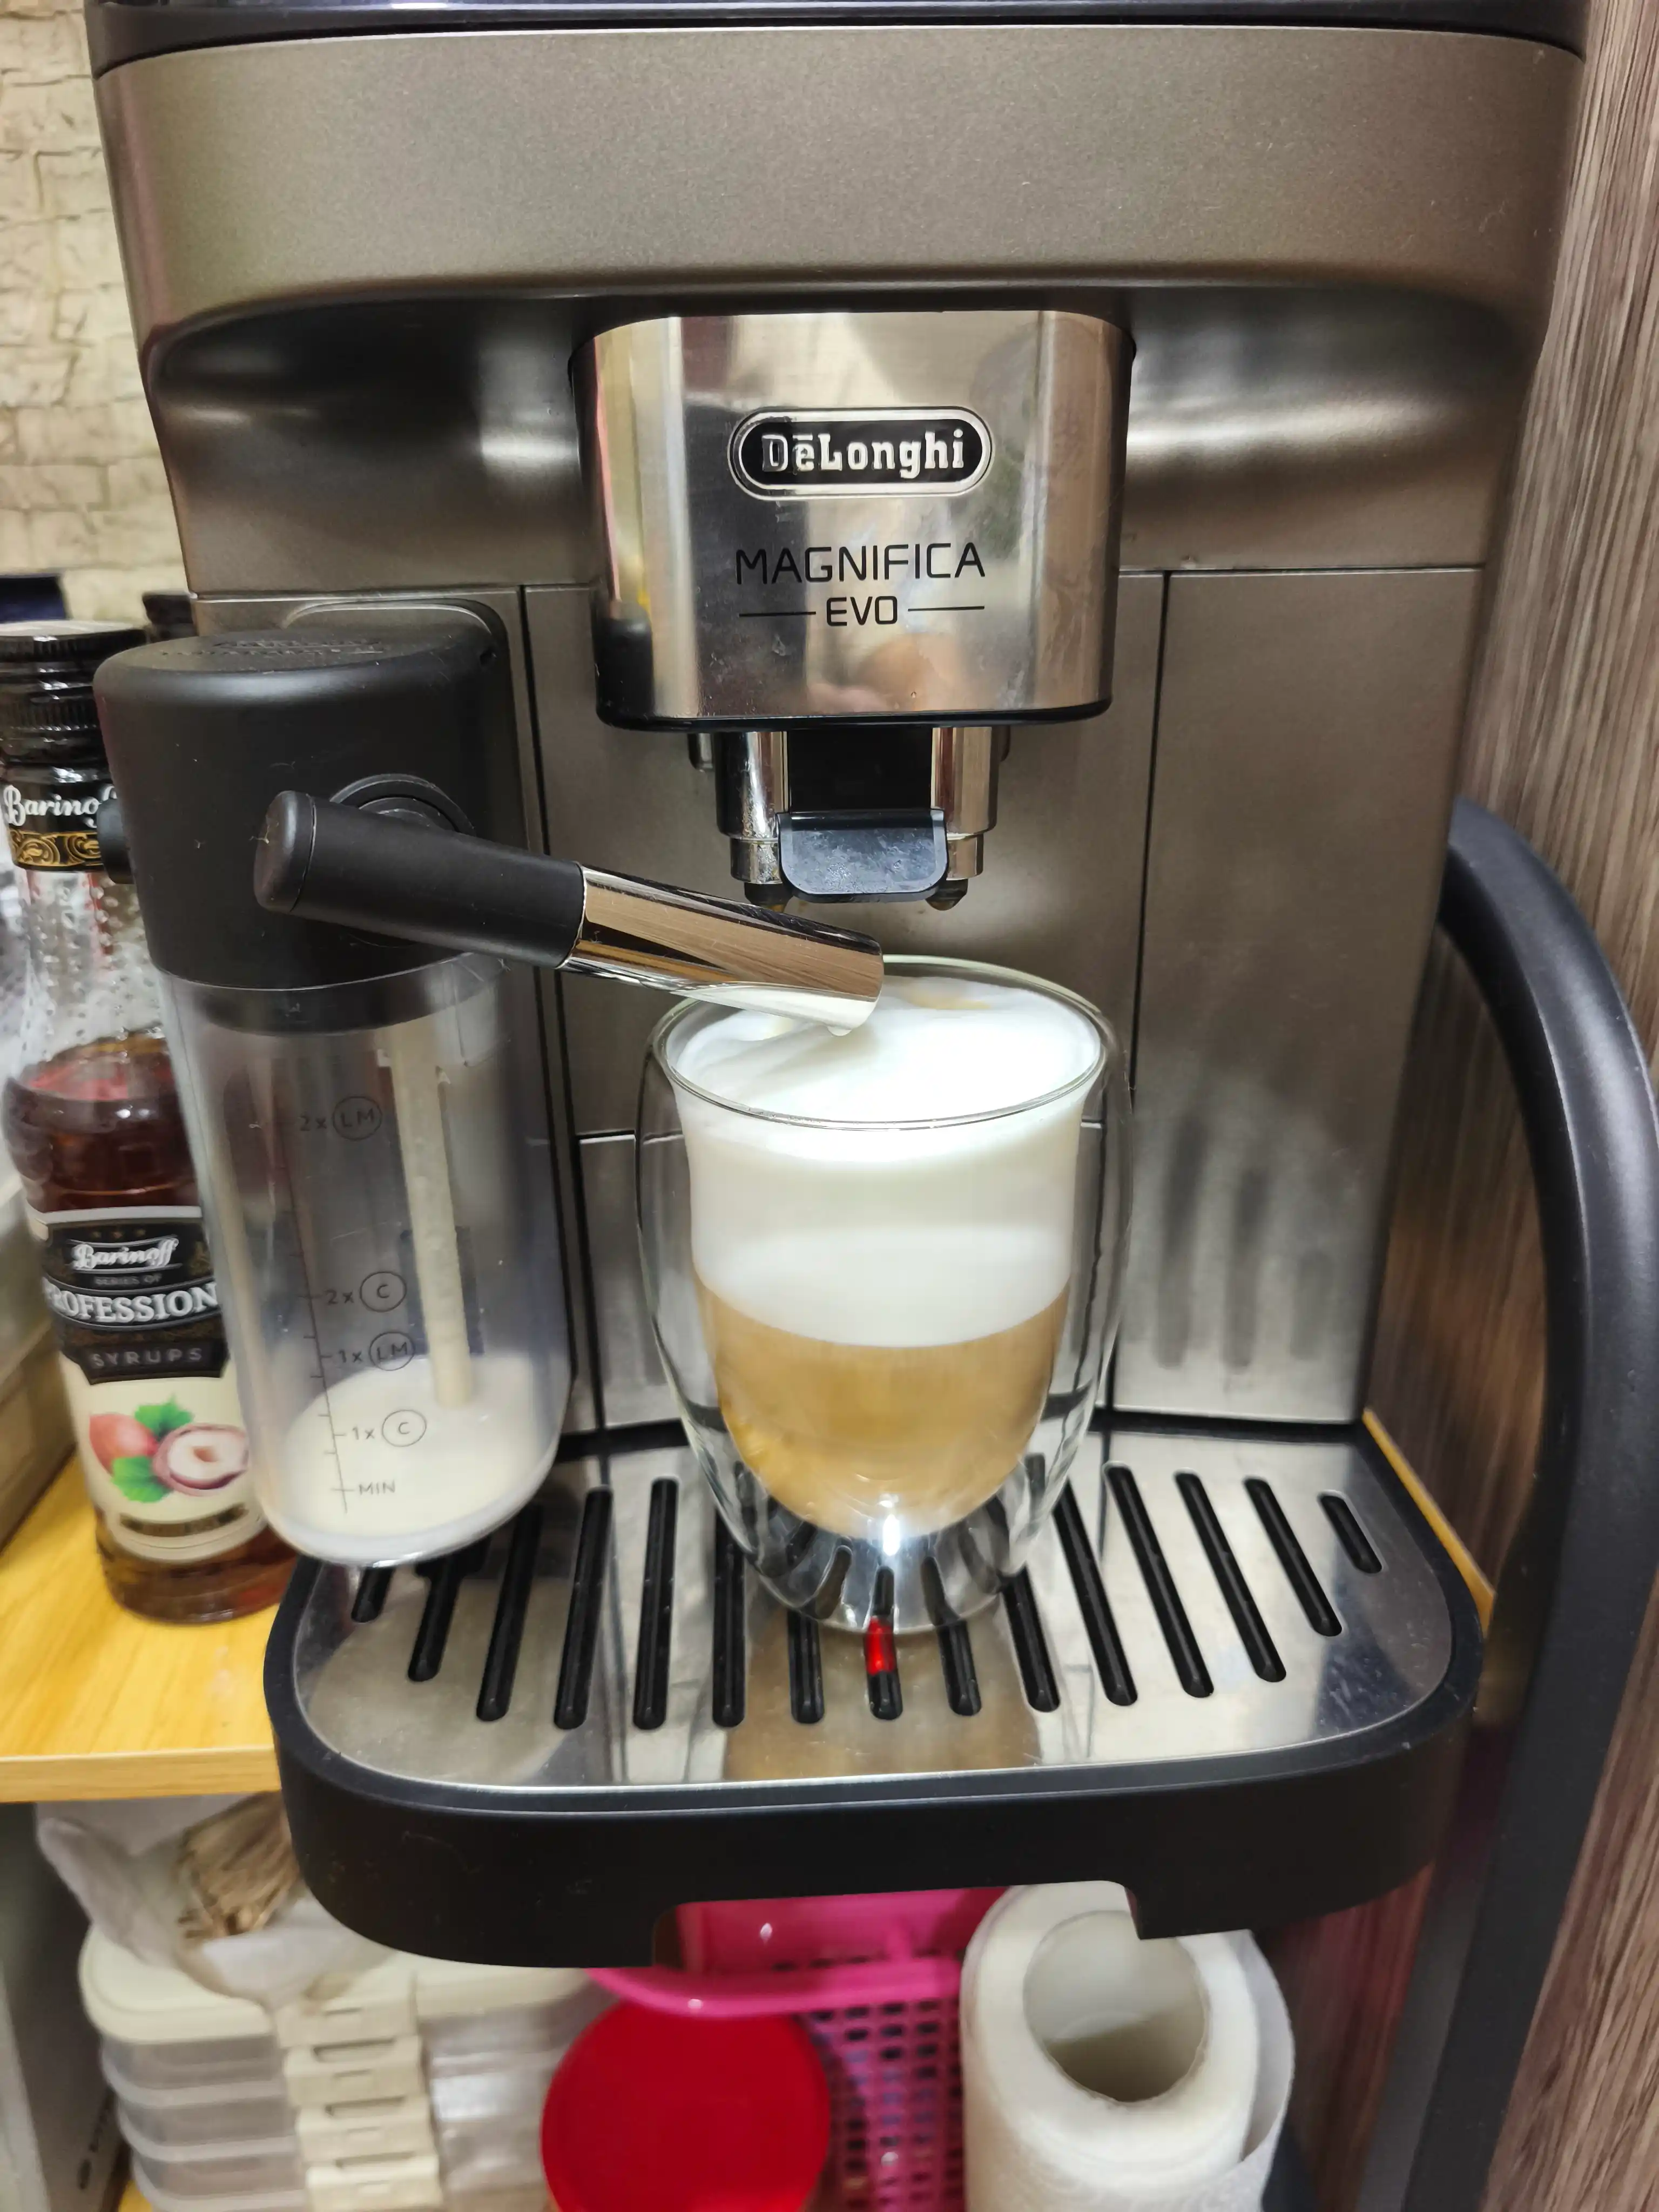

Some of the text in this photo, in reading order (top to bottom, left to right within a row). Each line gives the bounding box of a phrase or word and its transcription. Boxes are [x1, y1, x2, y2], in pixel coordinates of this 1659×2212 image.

[736, 542, 986, 585] MAGNIFICA
[826, 596, 898, 626] EVO
[340, 1108, 375, 1128] LM
[72, 1237, 179, 1269] Barinoff
[376, 1284, 389, 1299] C
[90, 1347, 203, 1368] SYRUPS
[376, 1341, 408, 1361] LM
[398, 1422, 410, 1435] C
[359, 1480, 396, 1496] MIN
